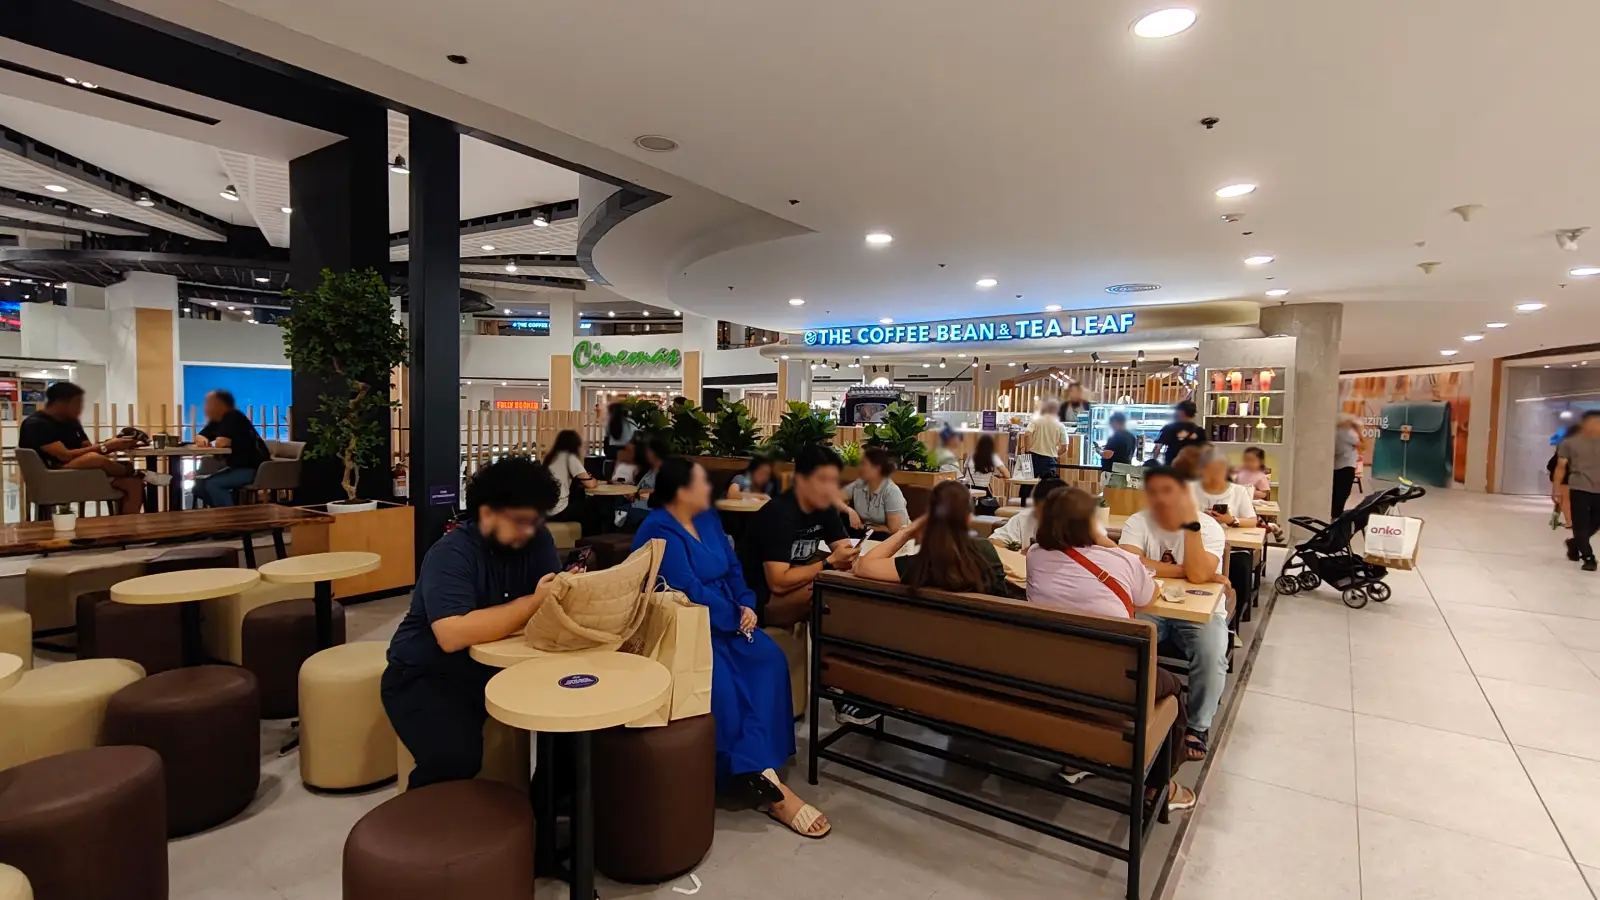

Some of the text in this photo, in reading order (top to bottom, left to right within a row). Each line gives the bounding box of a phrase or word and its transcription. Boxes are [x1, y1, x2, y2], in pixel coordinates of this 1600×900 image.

[819, 313, 1135, 345] THE COFFEE BEAN & TEA LEAF
[572, 340, 681, 369] Cinemas
[1363, 414, 1389, 429] azing
[1363, 428, 1381, 438] oon
[1370, 525, 1402, 536] anko
